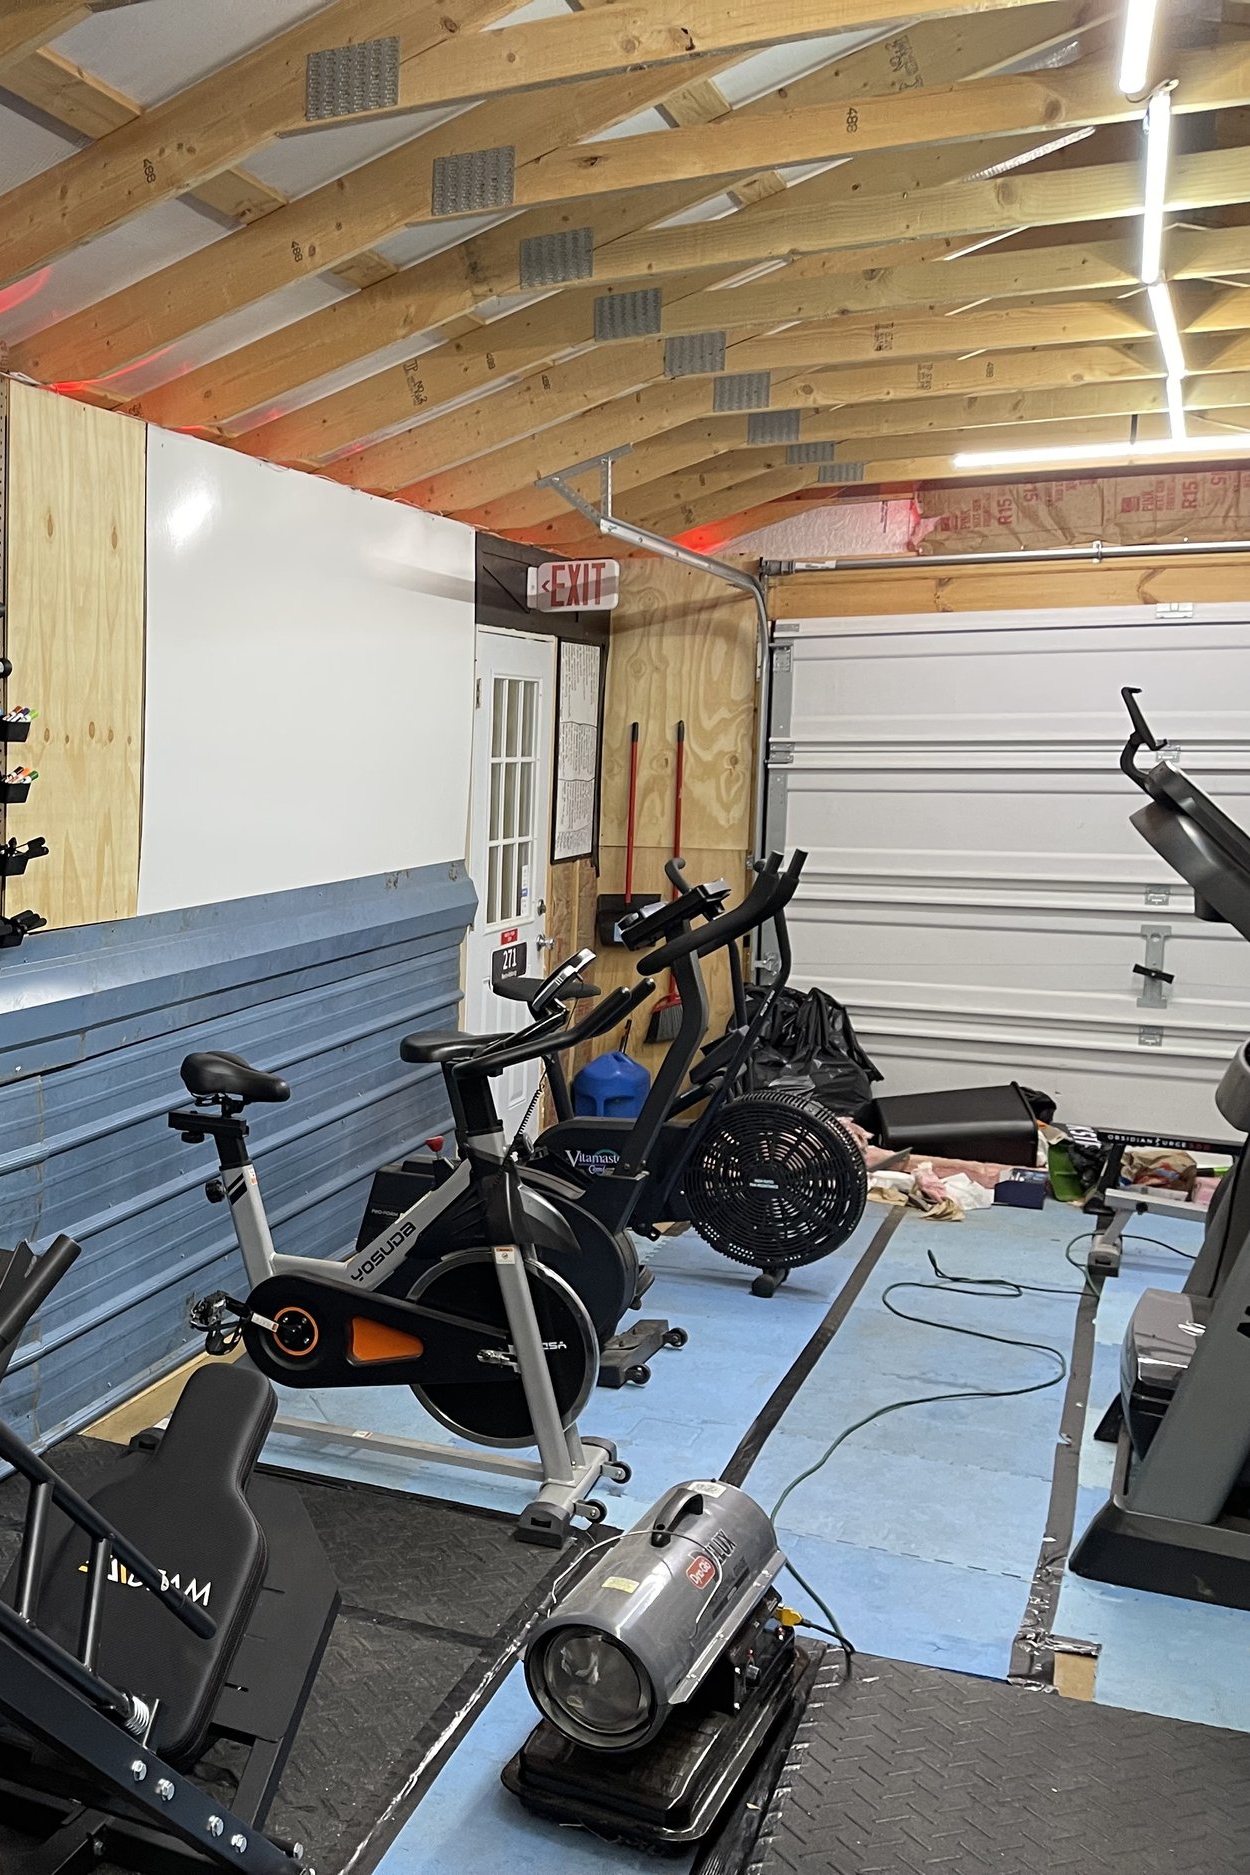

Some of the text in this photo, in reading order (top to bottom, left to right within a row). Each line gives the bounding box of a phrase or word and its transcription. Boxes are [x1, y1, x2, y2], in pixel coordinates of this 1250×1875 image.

[846, 107, 858, 133] 488
[143, 158, 156, 184] 488
[291, 240, 303, 262] 488
[1182, 481, 1198, 509] R15
[997, 498, 1013, 526] R15
[551, 562, 606, 607] EXIT
[502, 947, 517, 970] 271
[1107, 1133, 1153, 1145] OBSIDIAN
[350, 1221, 417, 1282] YOSUDA
